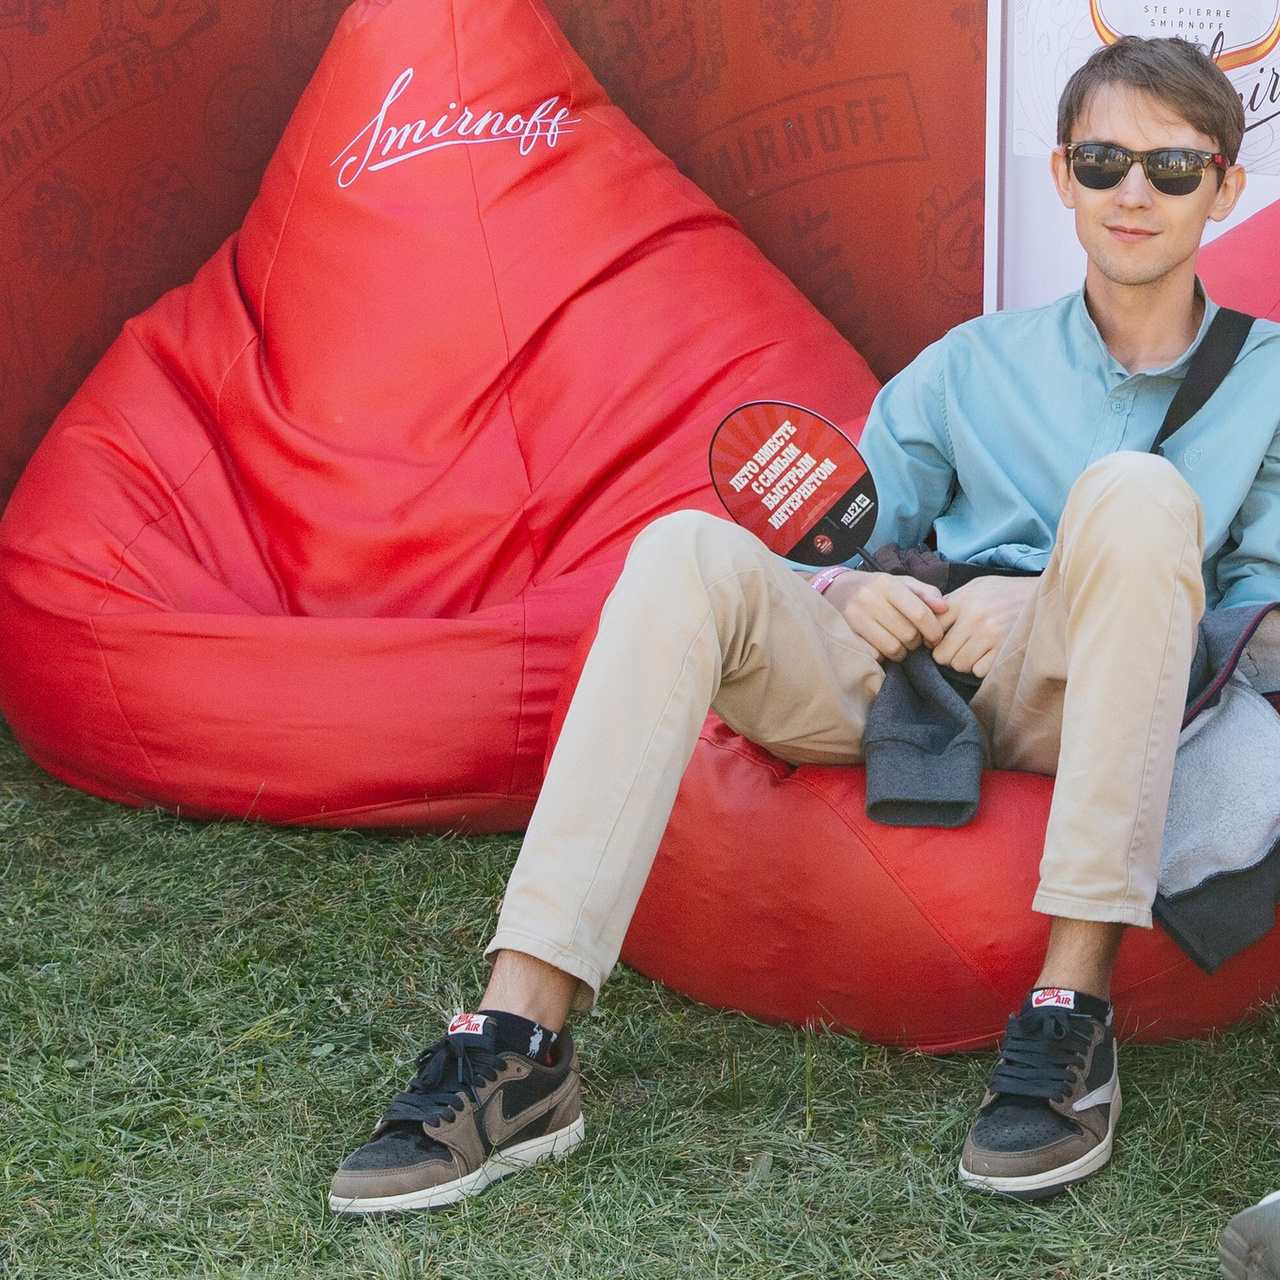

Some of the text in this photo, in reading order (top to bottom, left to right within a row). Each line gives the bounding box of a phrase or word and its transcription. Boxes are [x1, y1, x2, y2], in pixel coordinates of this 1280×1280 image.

[1144, 5, 1231, 18] STE PIERRE
[1151, 19, 1224, 31] SMIRNOFF
[330, 67, 582, 188] Smirnoff
[729, 420, 797, 493] ЛЕТО ВМЕСТЕ
[751, 442, 801, 495] С САМЫМ
[761, 452, 817, 511] БЫСТРЫМ
[767, 457, 837, 530] ИНТЕРНЕТОМ
[841, 502, 862, 525] TELE2
[1040, 989, 1062, 997] NIKE
[1055, 997, 1071, 1005] AIR
[457, 1014, 475, 1024] NIKE
[465, 1022, 480, 1032] AIR
